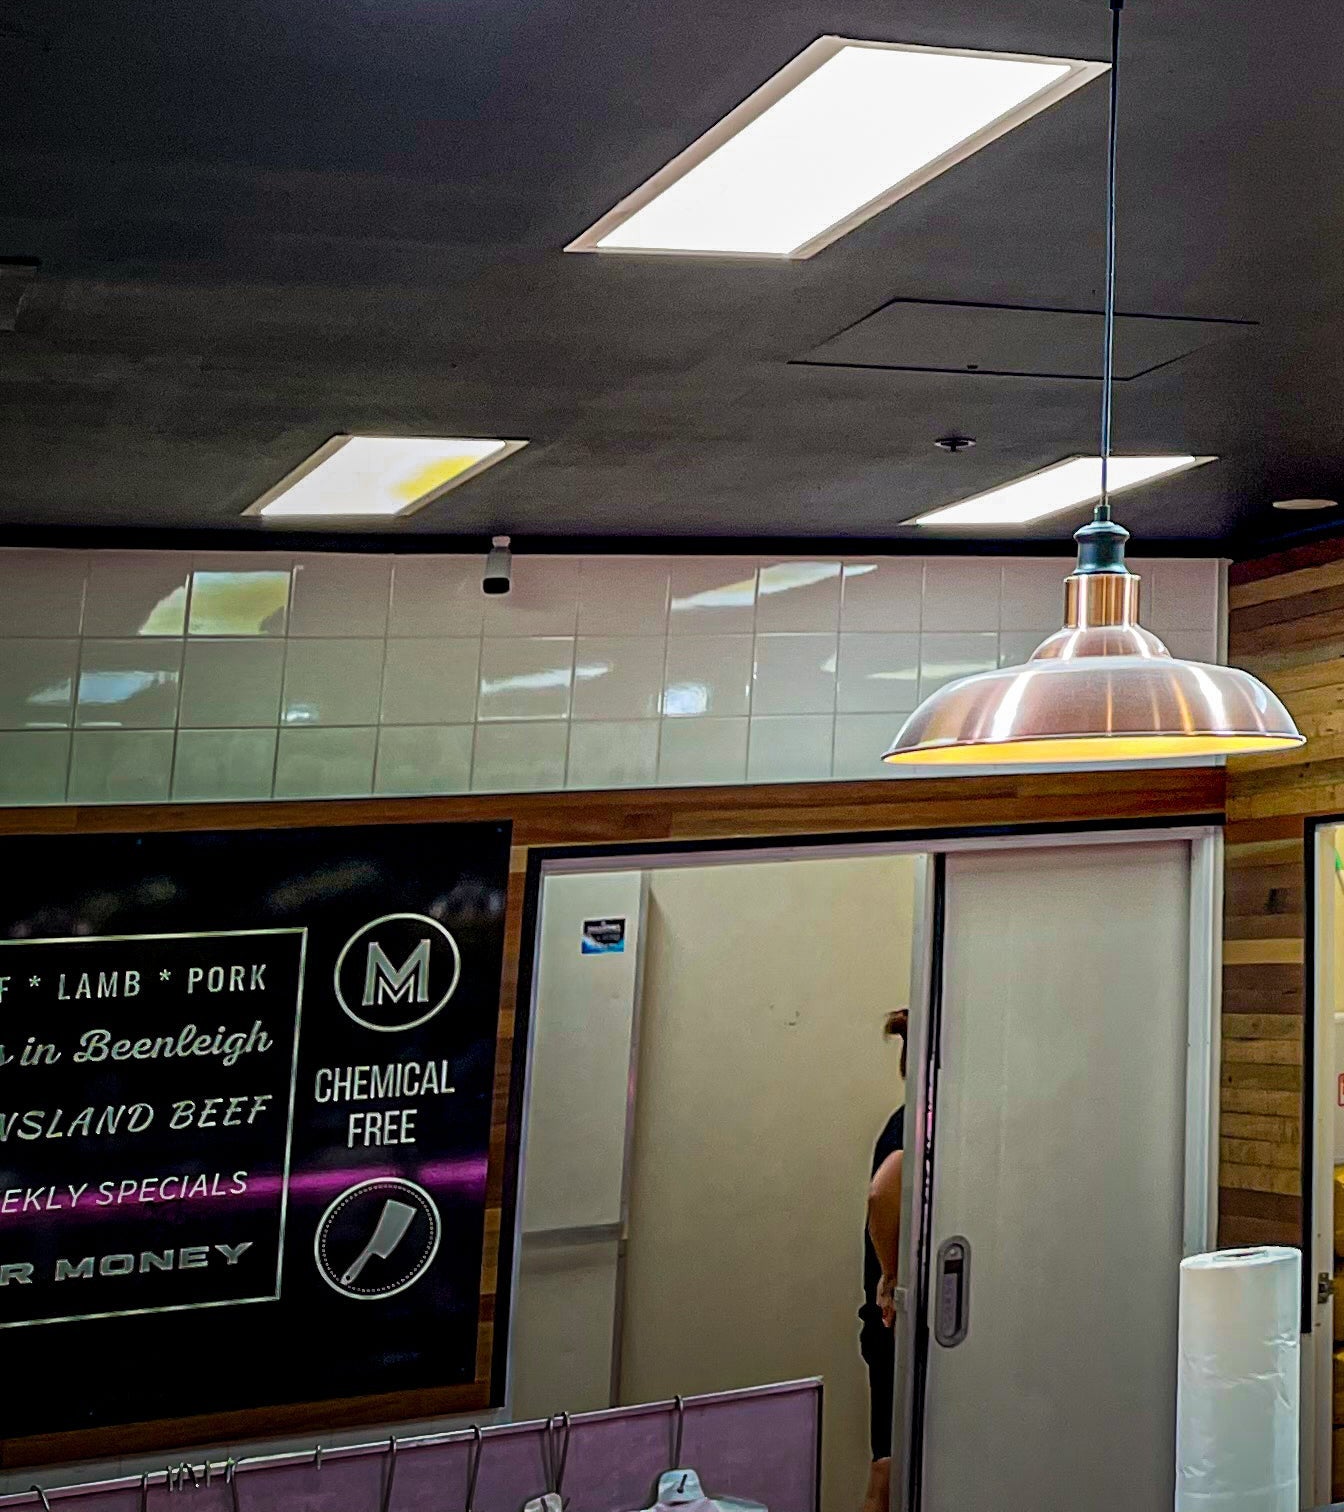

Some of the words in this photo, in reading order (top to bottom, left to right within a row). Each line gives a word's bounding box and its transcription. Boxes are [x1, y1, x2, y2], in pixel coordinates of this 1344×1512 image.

[58, 970, 140, 1000] LAMB
[187, 964, 267, 994] PORK
[19, 1037, 62, 1066] in
[73, 1020, 273, 1067] Beenleigh
[314, 1059, 456, 1104] CHEMICAL
[169, 1094, 273, 1130] BEEF
[347, 1109, 418, 1149] FREE
[96, 1171, 248, 1205] SPECIALS
[54, 1241, 253, 1281] MONEY
